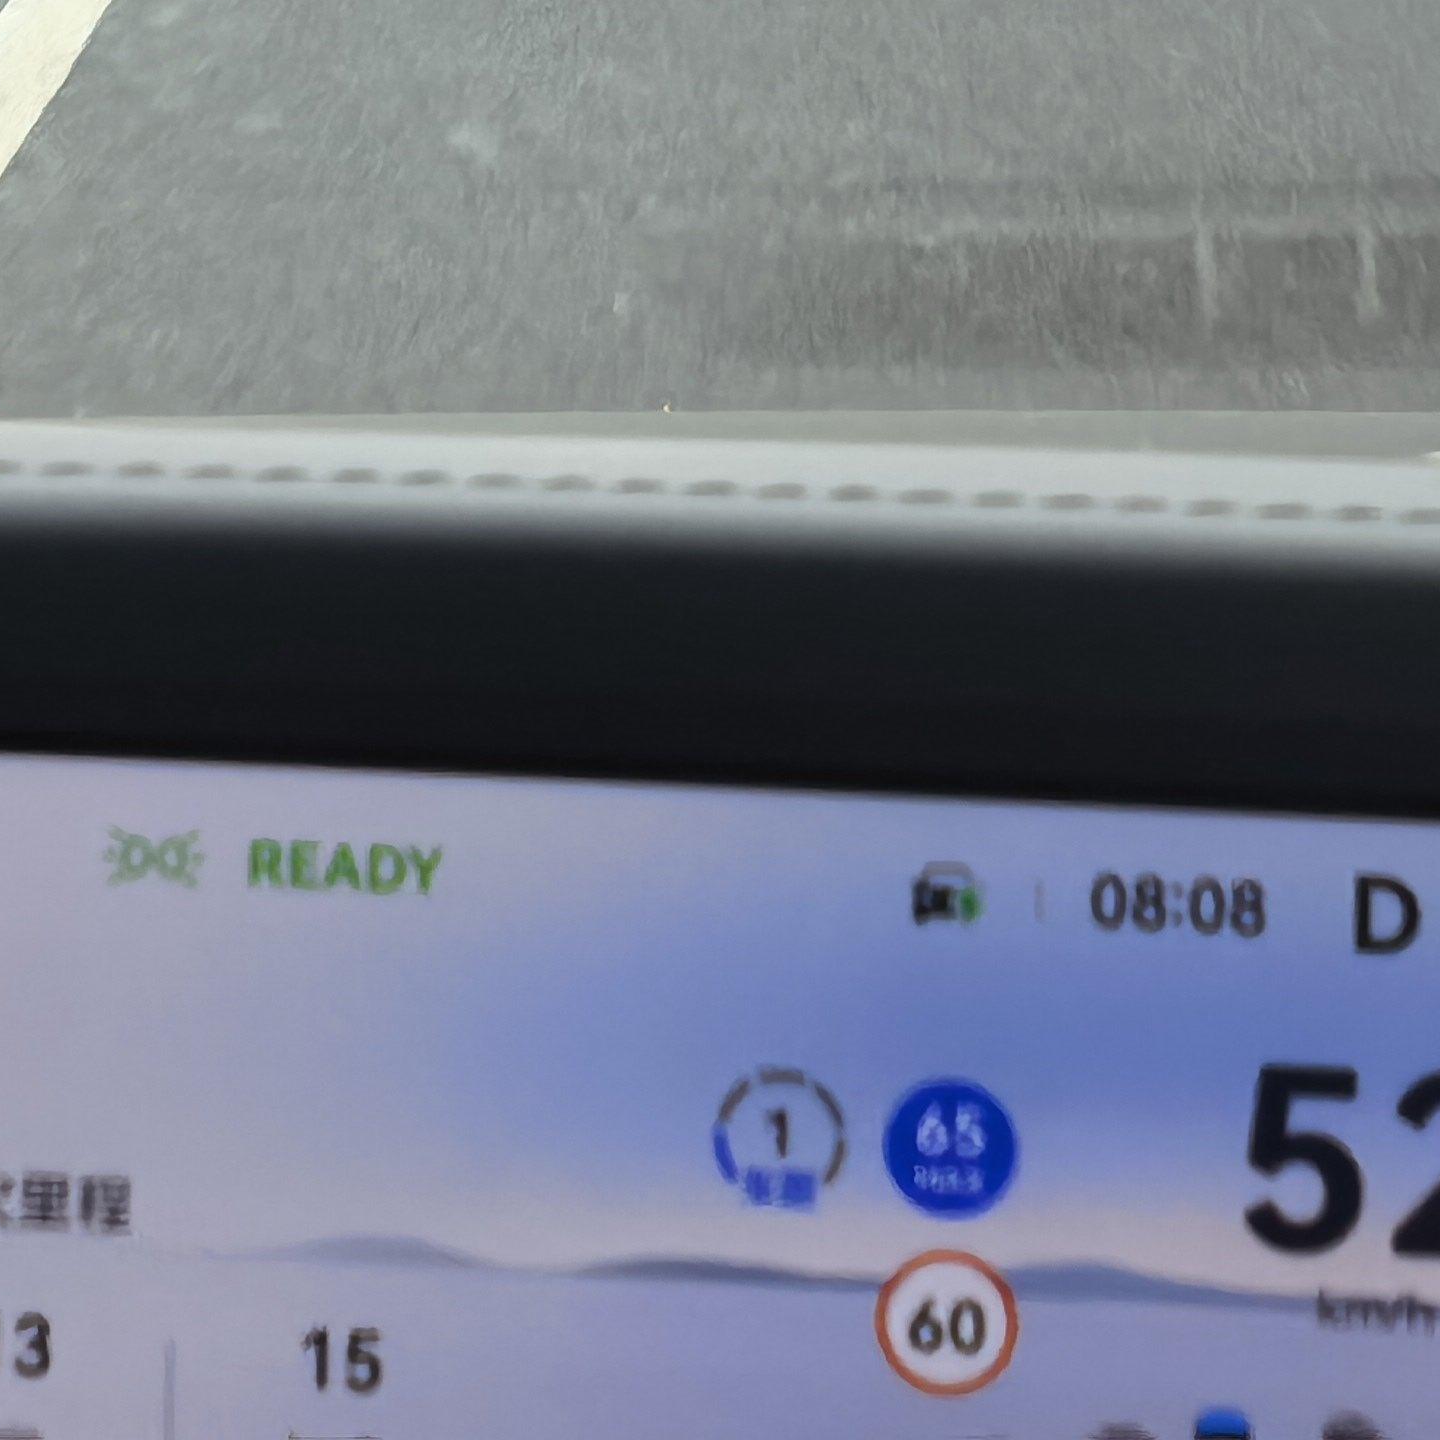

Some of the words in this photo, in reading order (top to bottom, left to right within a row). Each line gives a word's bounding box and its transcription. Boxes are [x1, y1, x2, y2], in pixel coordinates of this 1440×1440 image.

[247, 837, 442, 894] READY
[1090, 871, 1267, 938] 08:08
[1354, 873, 1421, 953] D
[766, 1105, 789, 1159] 1
[908, 1296, 986, 1356] 60
[299, 1324, 383, 1394] 15
